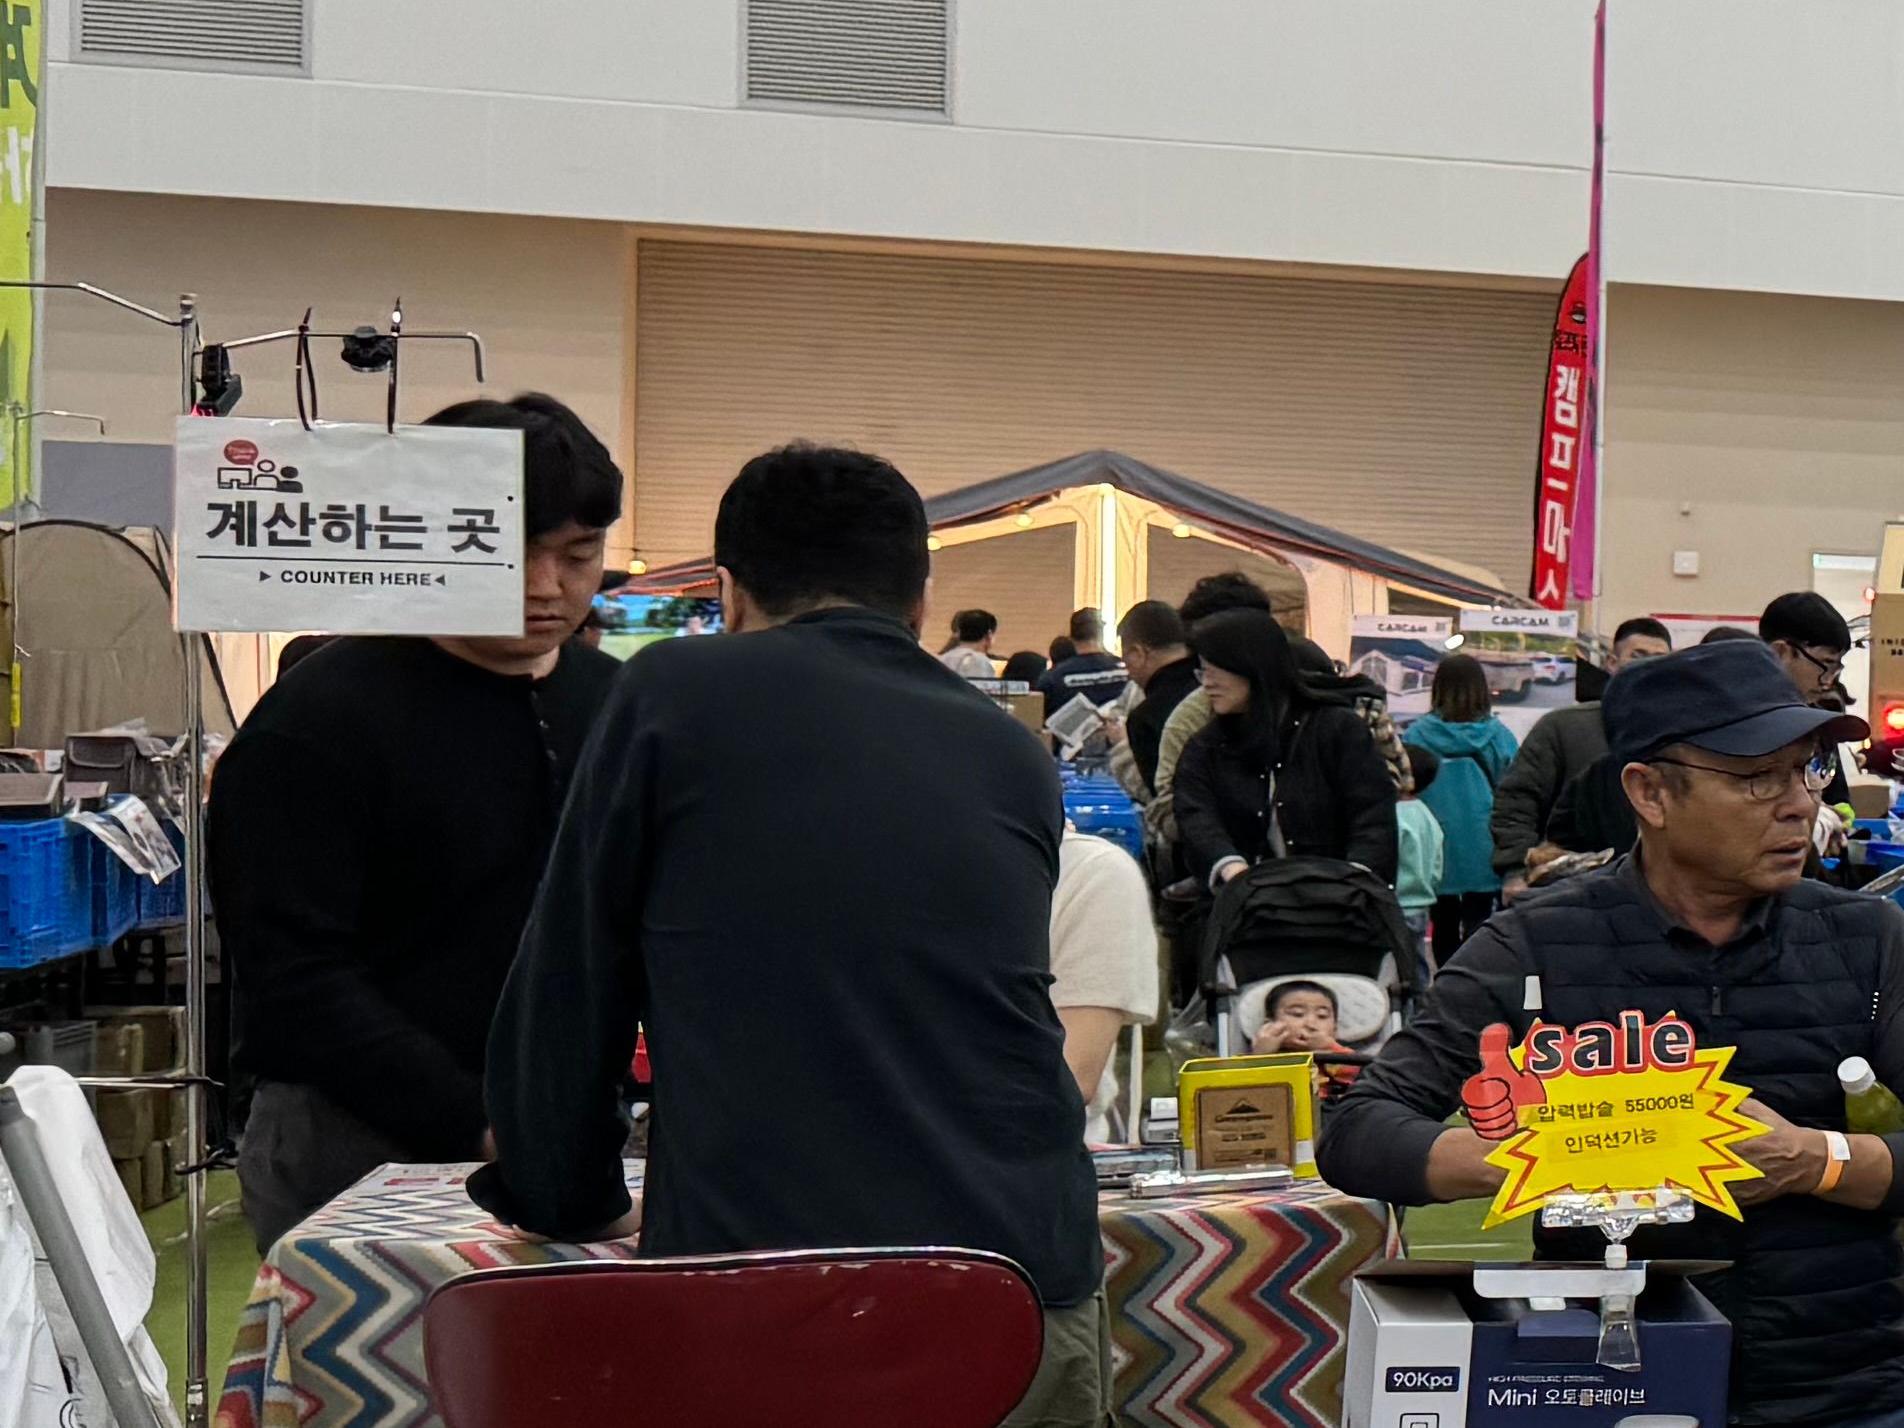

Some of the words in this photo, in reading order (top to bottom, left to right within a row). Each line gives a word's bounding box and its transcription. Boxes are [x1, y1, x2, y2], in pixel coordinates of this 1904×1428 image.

[206, 501, 428, 551] 계산하는
[446, 506, 501, 554] 곳
[280, 570, 374, 586] COUNTER
[380, 571, 432, 587] HERE
[1528, 1010, 1693, 1071] sale
[1624, 1093, 1695, 1115] 55000원
[1564, 1126, 1658, 1155] 인덕션가능
[1392, 1372, 1454, 1391] 90Kpa
[1487, 1388, 1538, 1407] Mini
[1543, 1388, 1647, 1407] 오토클레이브
